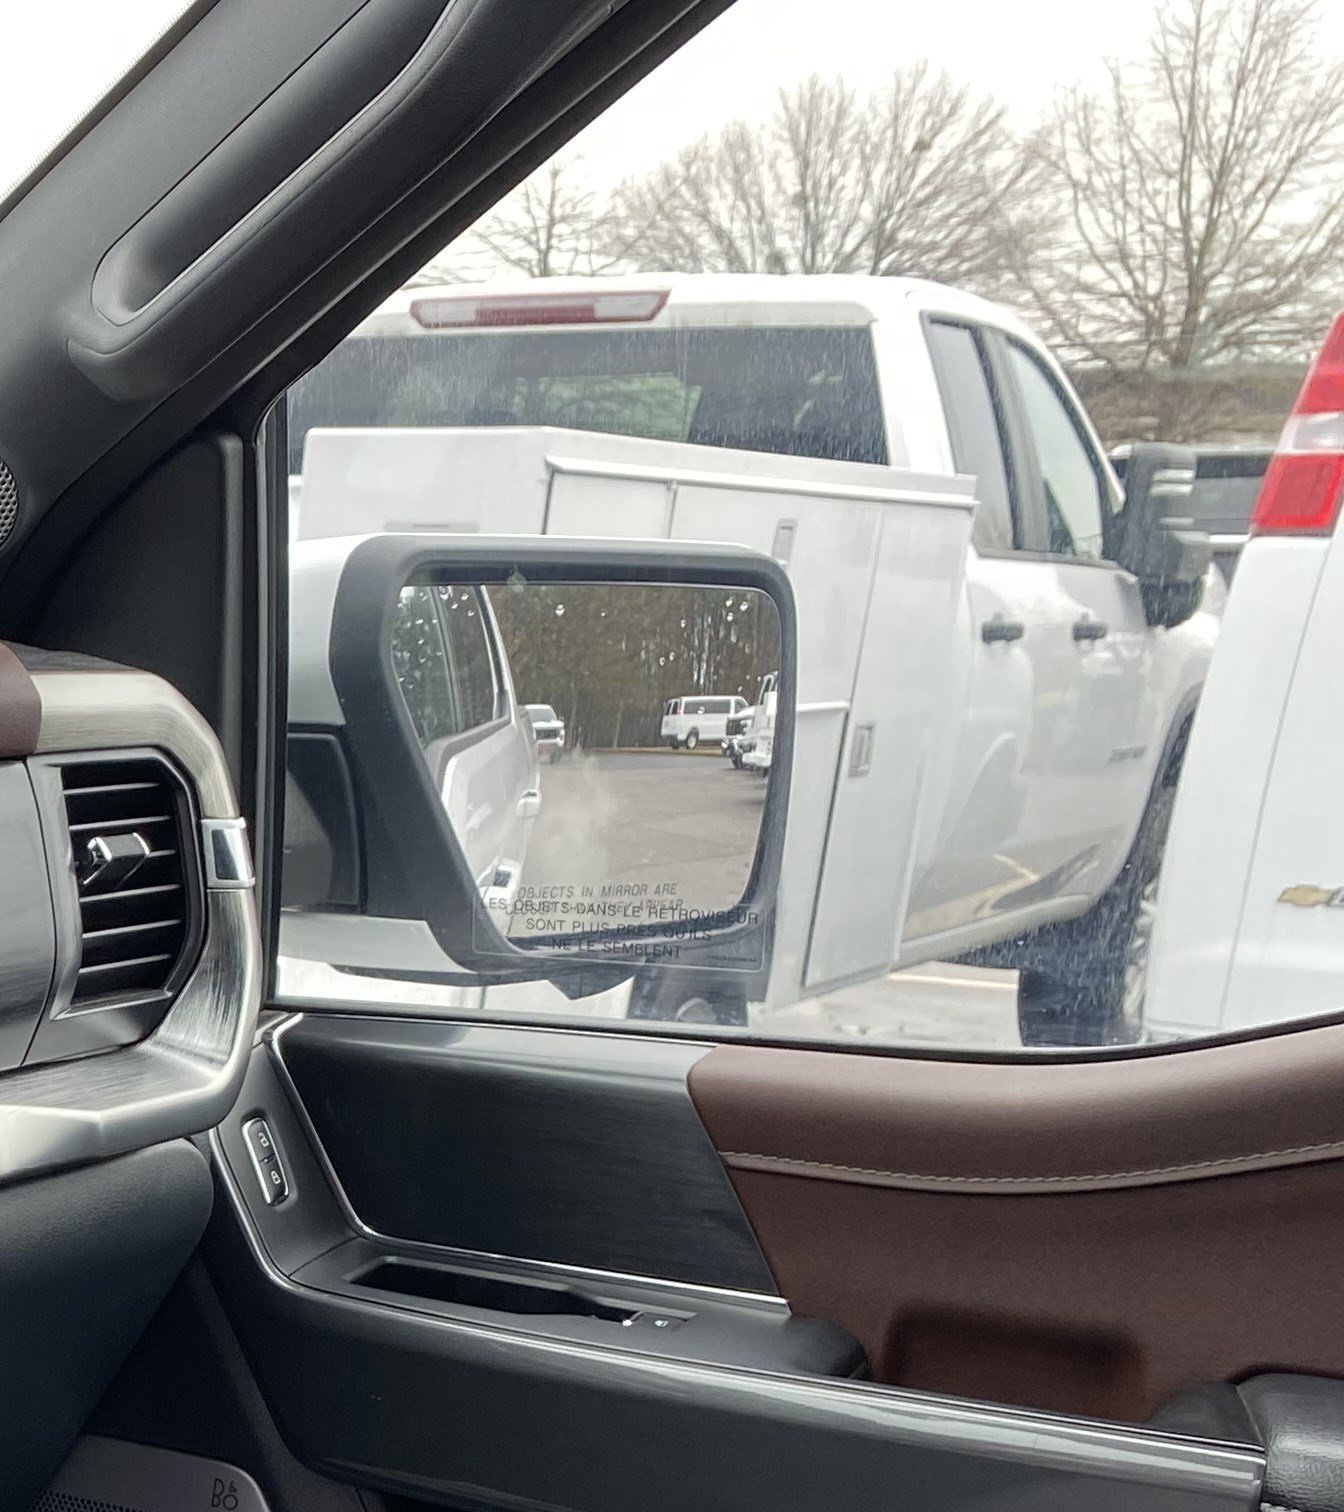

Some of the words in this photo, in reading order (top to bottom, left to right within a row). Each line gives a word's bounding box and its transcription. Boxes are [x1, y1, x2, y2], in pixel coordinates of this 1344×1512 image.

[517, 886, 574, 899] OBJECTS
[581, 885, 593, 898] IN
[601, 884, 648, 898] MIRROR
[654, 883, 678, 895] ARE
[623, 906, 641, 918] LE
[526, 918, 565, 931] SONT
[573, 921, 609, 934] PLUS
[578, 940, 595, 952] LE
[602, 941, 682, 958] SEMBLENT
